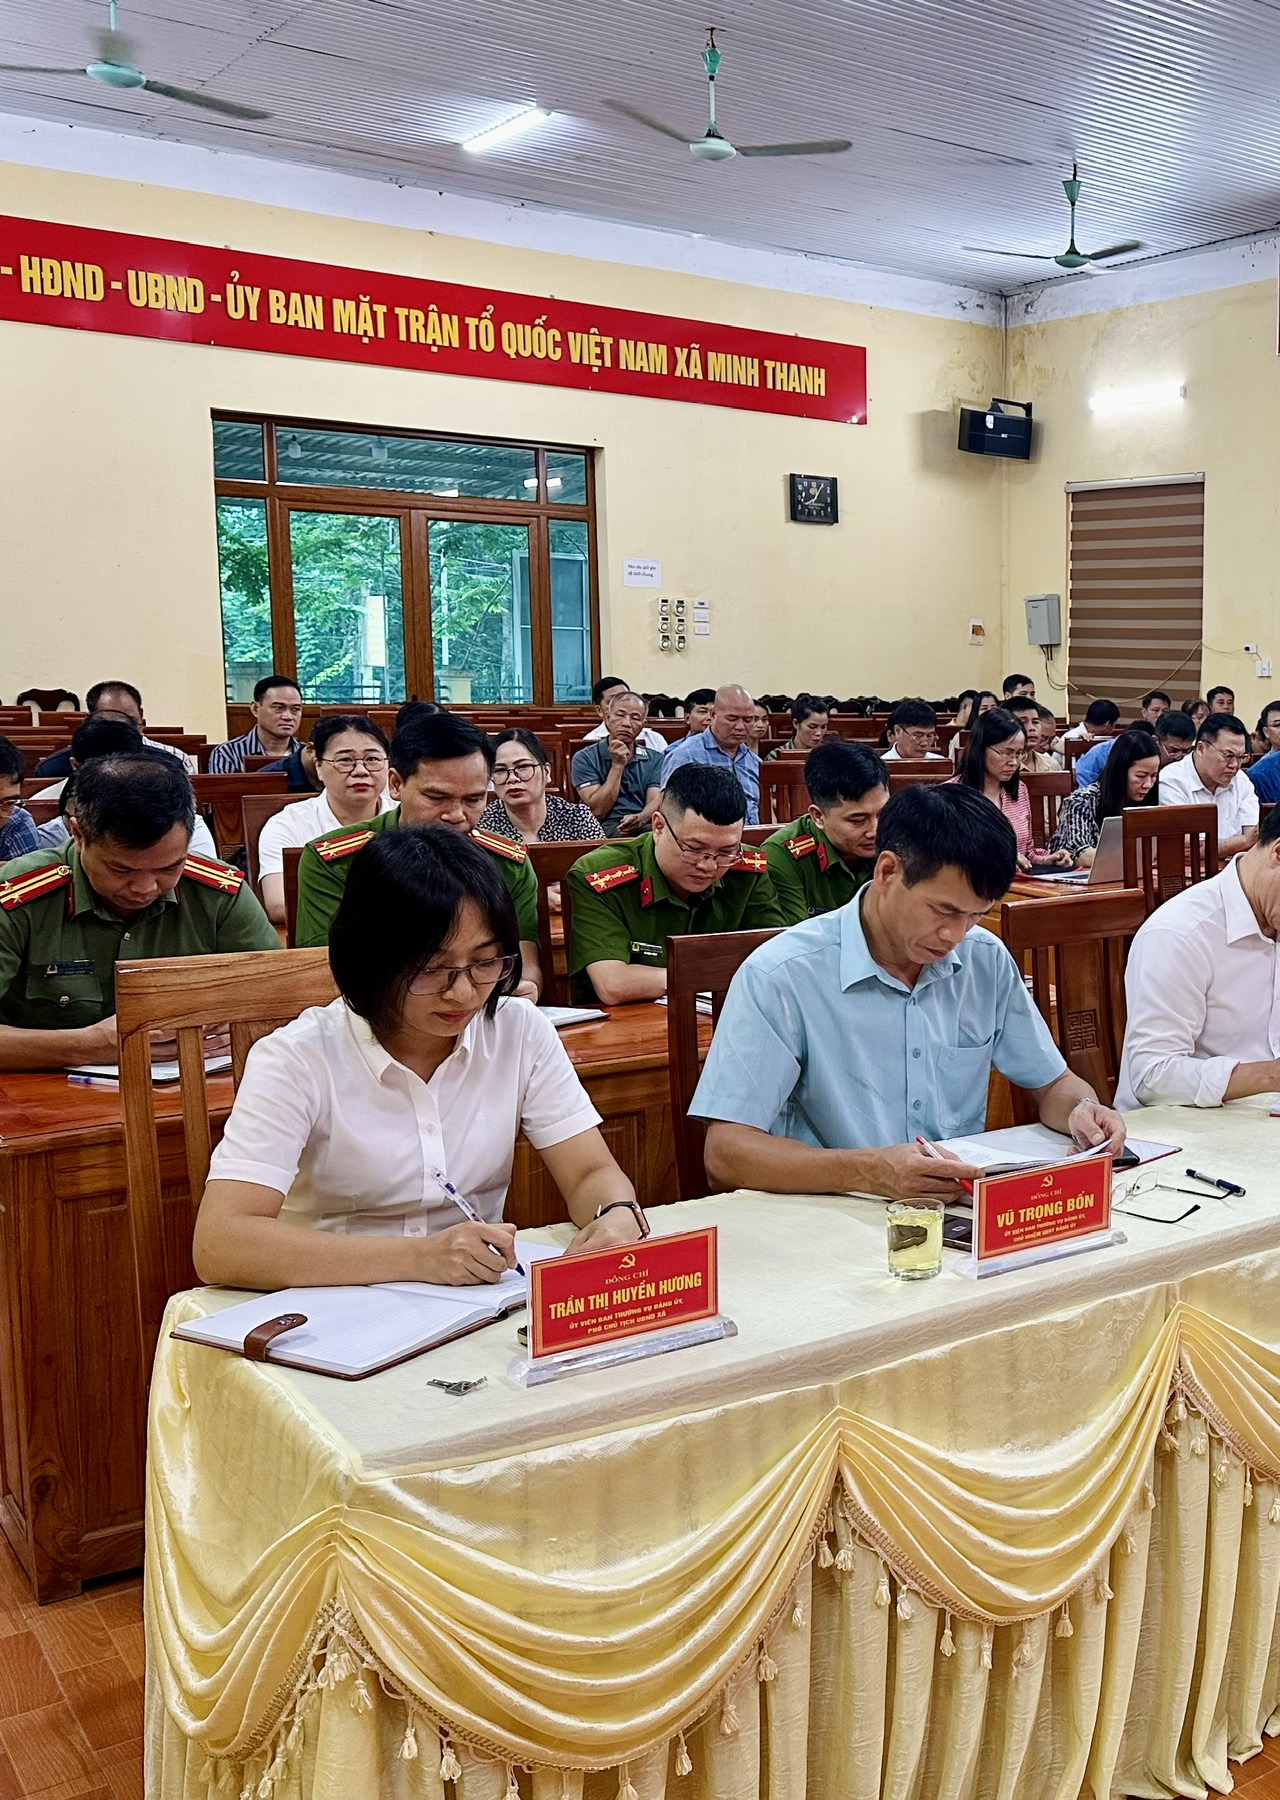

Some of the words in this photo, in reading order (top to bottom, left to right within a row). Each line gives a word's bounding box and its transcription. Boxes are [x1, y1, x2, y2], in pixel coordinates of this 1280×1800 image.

[19, 254, 105, 302] HĐND
[127, 269, 205, 314] UBND
[226, 270, 261, 321] ỦY
[268, 289, 324, 331] BAN
[332, 294, 387, 344] MẶT
[394, 304, 460, 353] TRẬN
[464, 304, 495, 353] TỔ
[501, 315, 562, 361] QUỐC
[567, 327, 614, 373] VIỆT
[618, 338, 668, 375] NAM
[674, 343, 704, 380] XÃ
[707, 351, 760, 388] MINH
[763, 359, 826, 397] THANH
[996, 1208, 1015, 1228] VŨ
[1018, 1200, 1063, 1223] TRỌNG
[1066, 1190, 1095, 1212] BỐN
[632, 1268, 649, 1280] CHÍ
[549, 1294, 585, 1320] TRẦN
[588, 1292, 609, 1310] THỊ
[612, 1279, 656, 1304] HUYỀN
[659, 1271, 702, 1296] HƯƠNG
[598, 1314, 614, 1323] BAN
[636, 1313, 656, 1323] UBND
